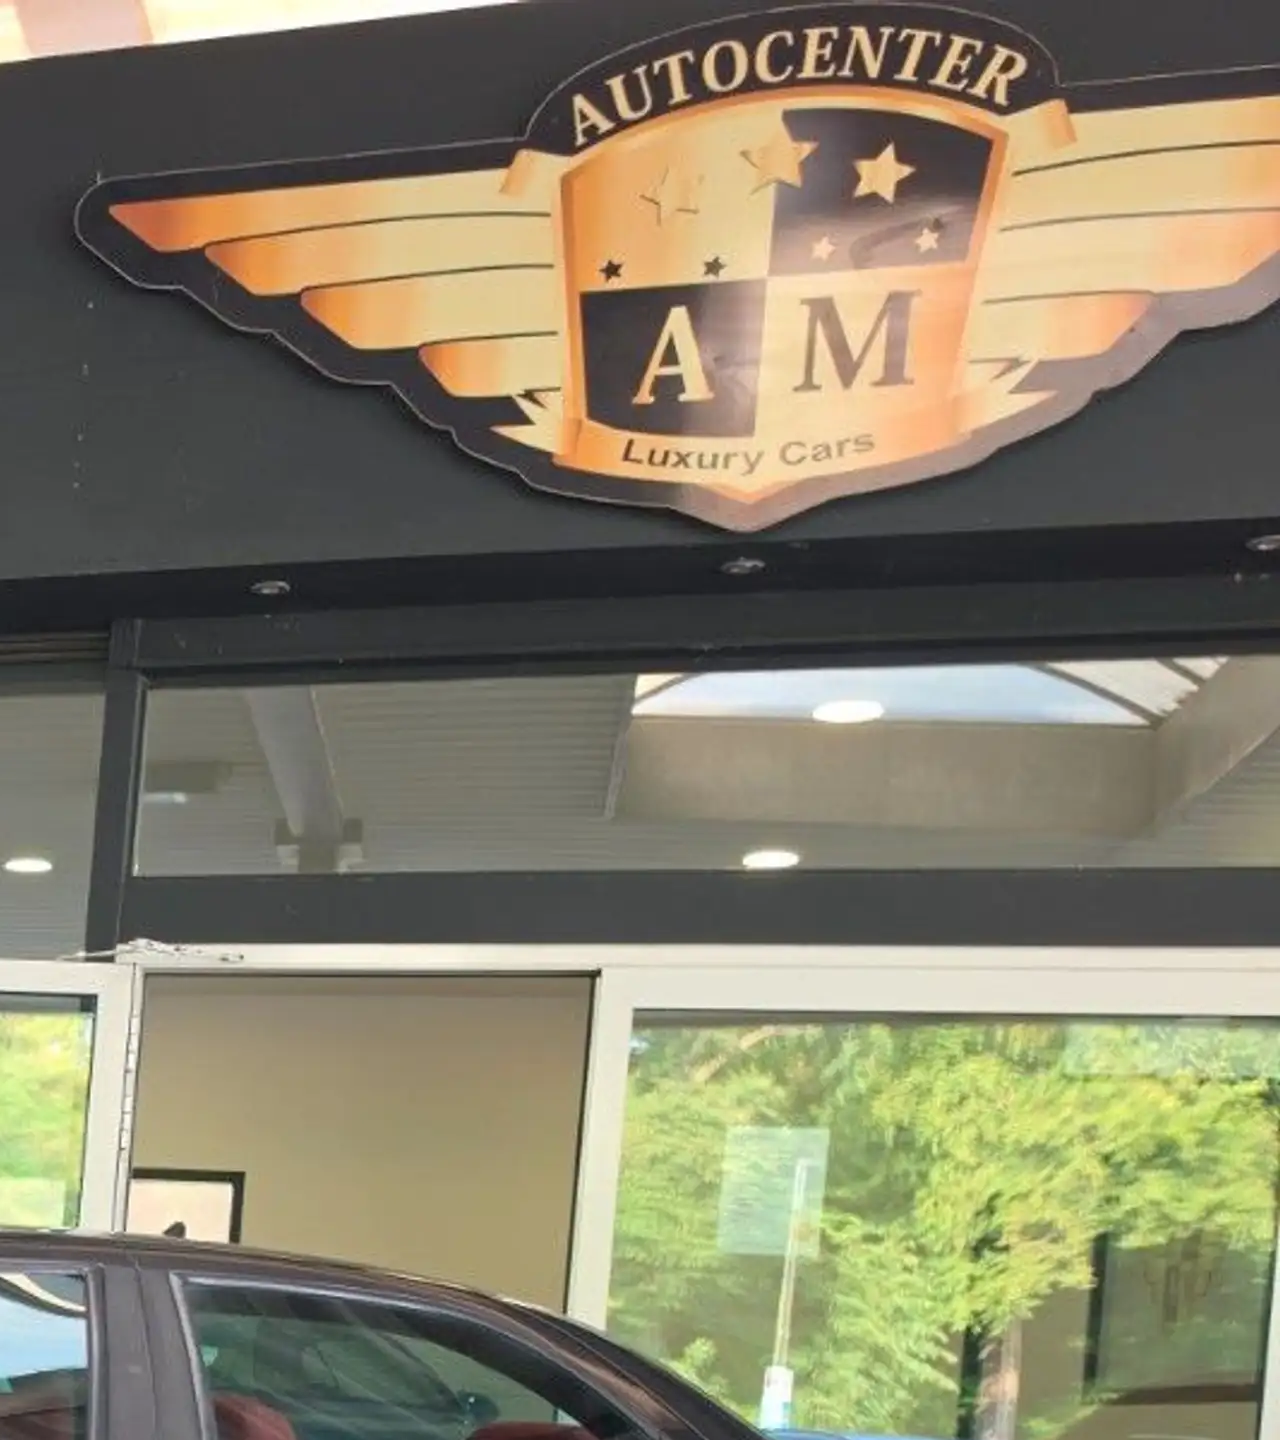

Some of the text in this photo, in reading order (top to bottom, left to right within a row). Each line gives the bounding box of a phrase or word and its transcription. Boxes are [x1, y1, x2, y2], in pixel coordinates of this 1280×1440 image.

[571, 25, 1029, 147] AUTOCENTER
[631, 288, 923, 405] A M
[621, 432, 876, 475] Luxury Cars
